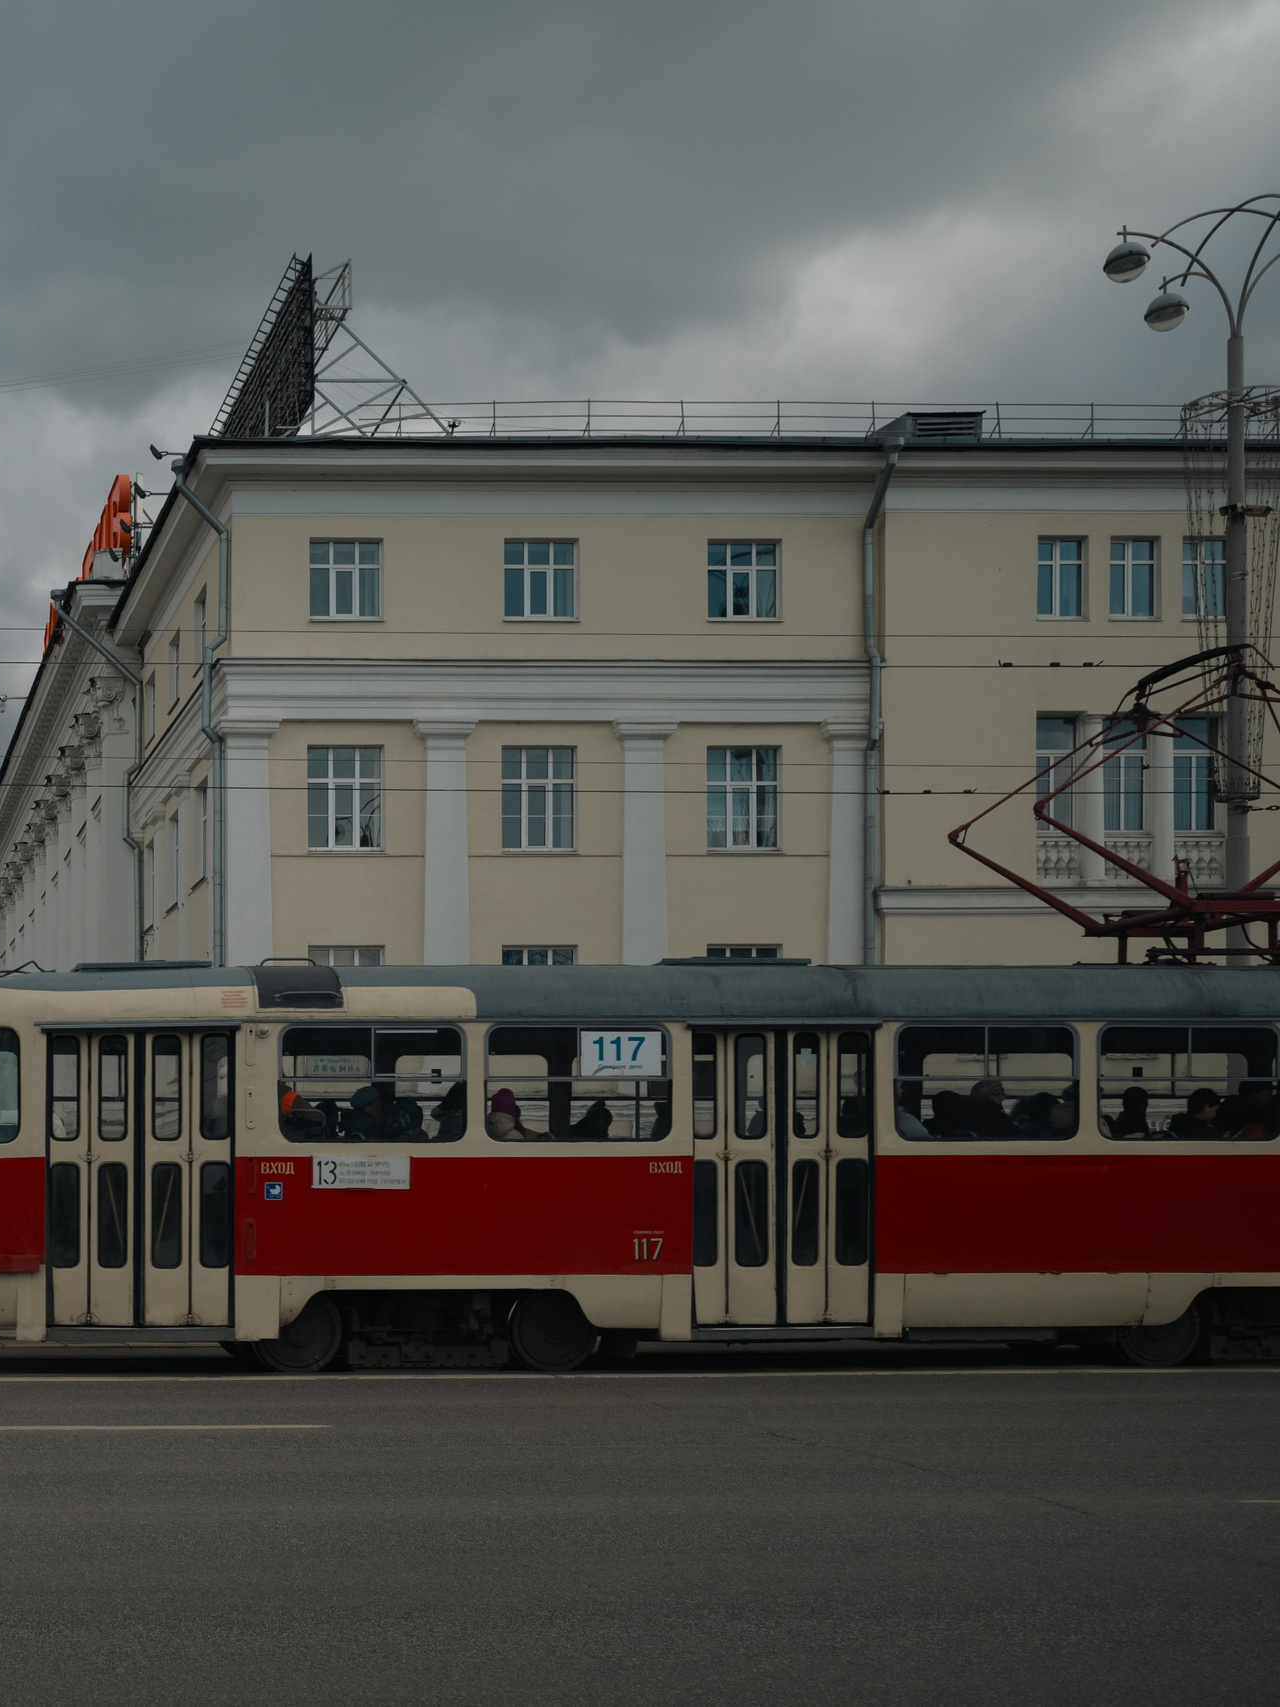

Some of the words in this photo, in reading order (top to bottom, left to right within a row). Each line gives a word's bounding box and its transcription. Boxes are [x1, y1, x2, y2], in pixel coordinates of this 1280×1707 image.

[592, 1036, 645, 1061] 117
[260, 1162, 295, 1175] ВХОД
[316, 1160, 337, 1185] 13
[648, 1161, 683, 1174] ВХОД
[632, 1238, 664, 1261] 117
